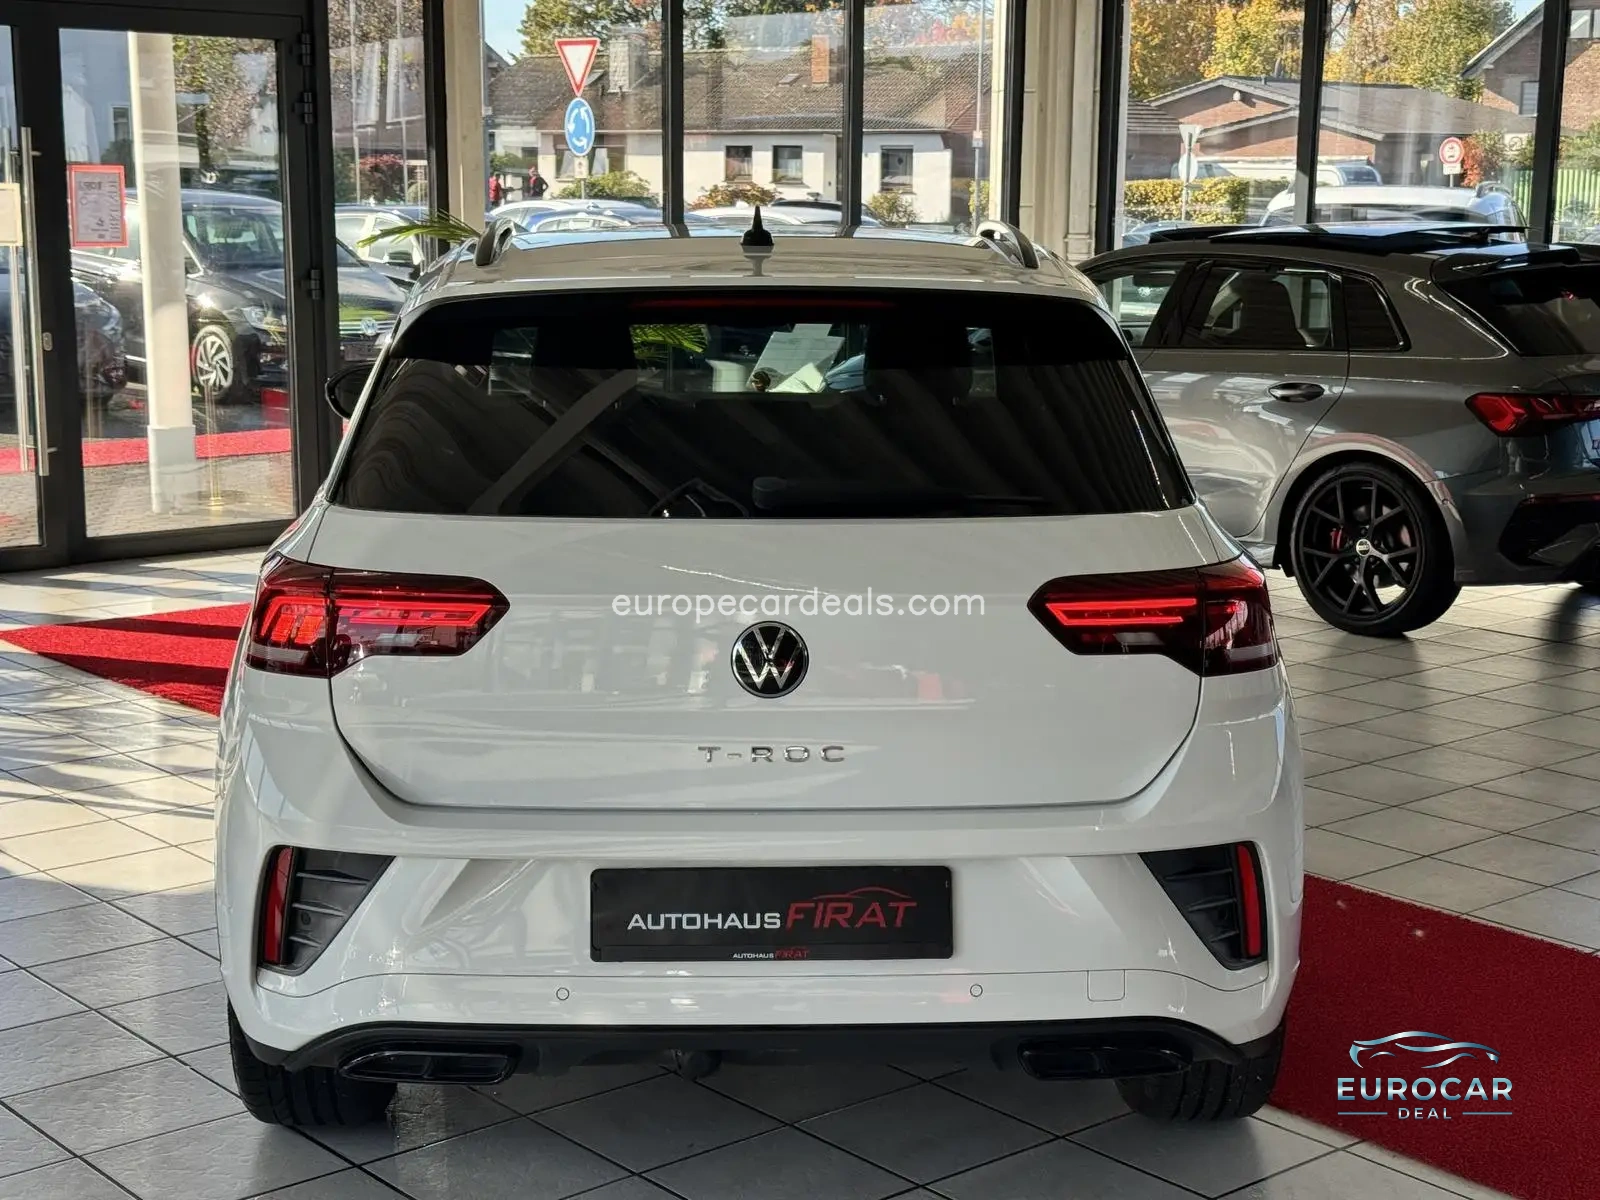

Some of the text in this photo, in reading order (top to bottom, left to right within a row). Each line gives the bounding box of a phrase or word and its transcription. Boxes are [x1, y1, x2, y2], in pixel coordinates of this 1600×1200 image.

[698, 746, 845, 762] T-ROC
[627, 901, 917, 931] AUTOHAUS FIRAT
[775, 949, 809, 959] FIRAT
